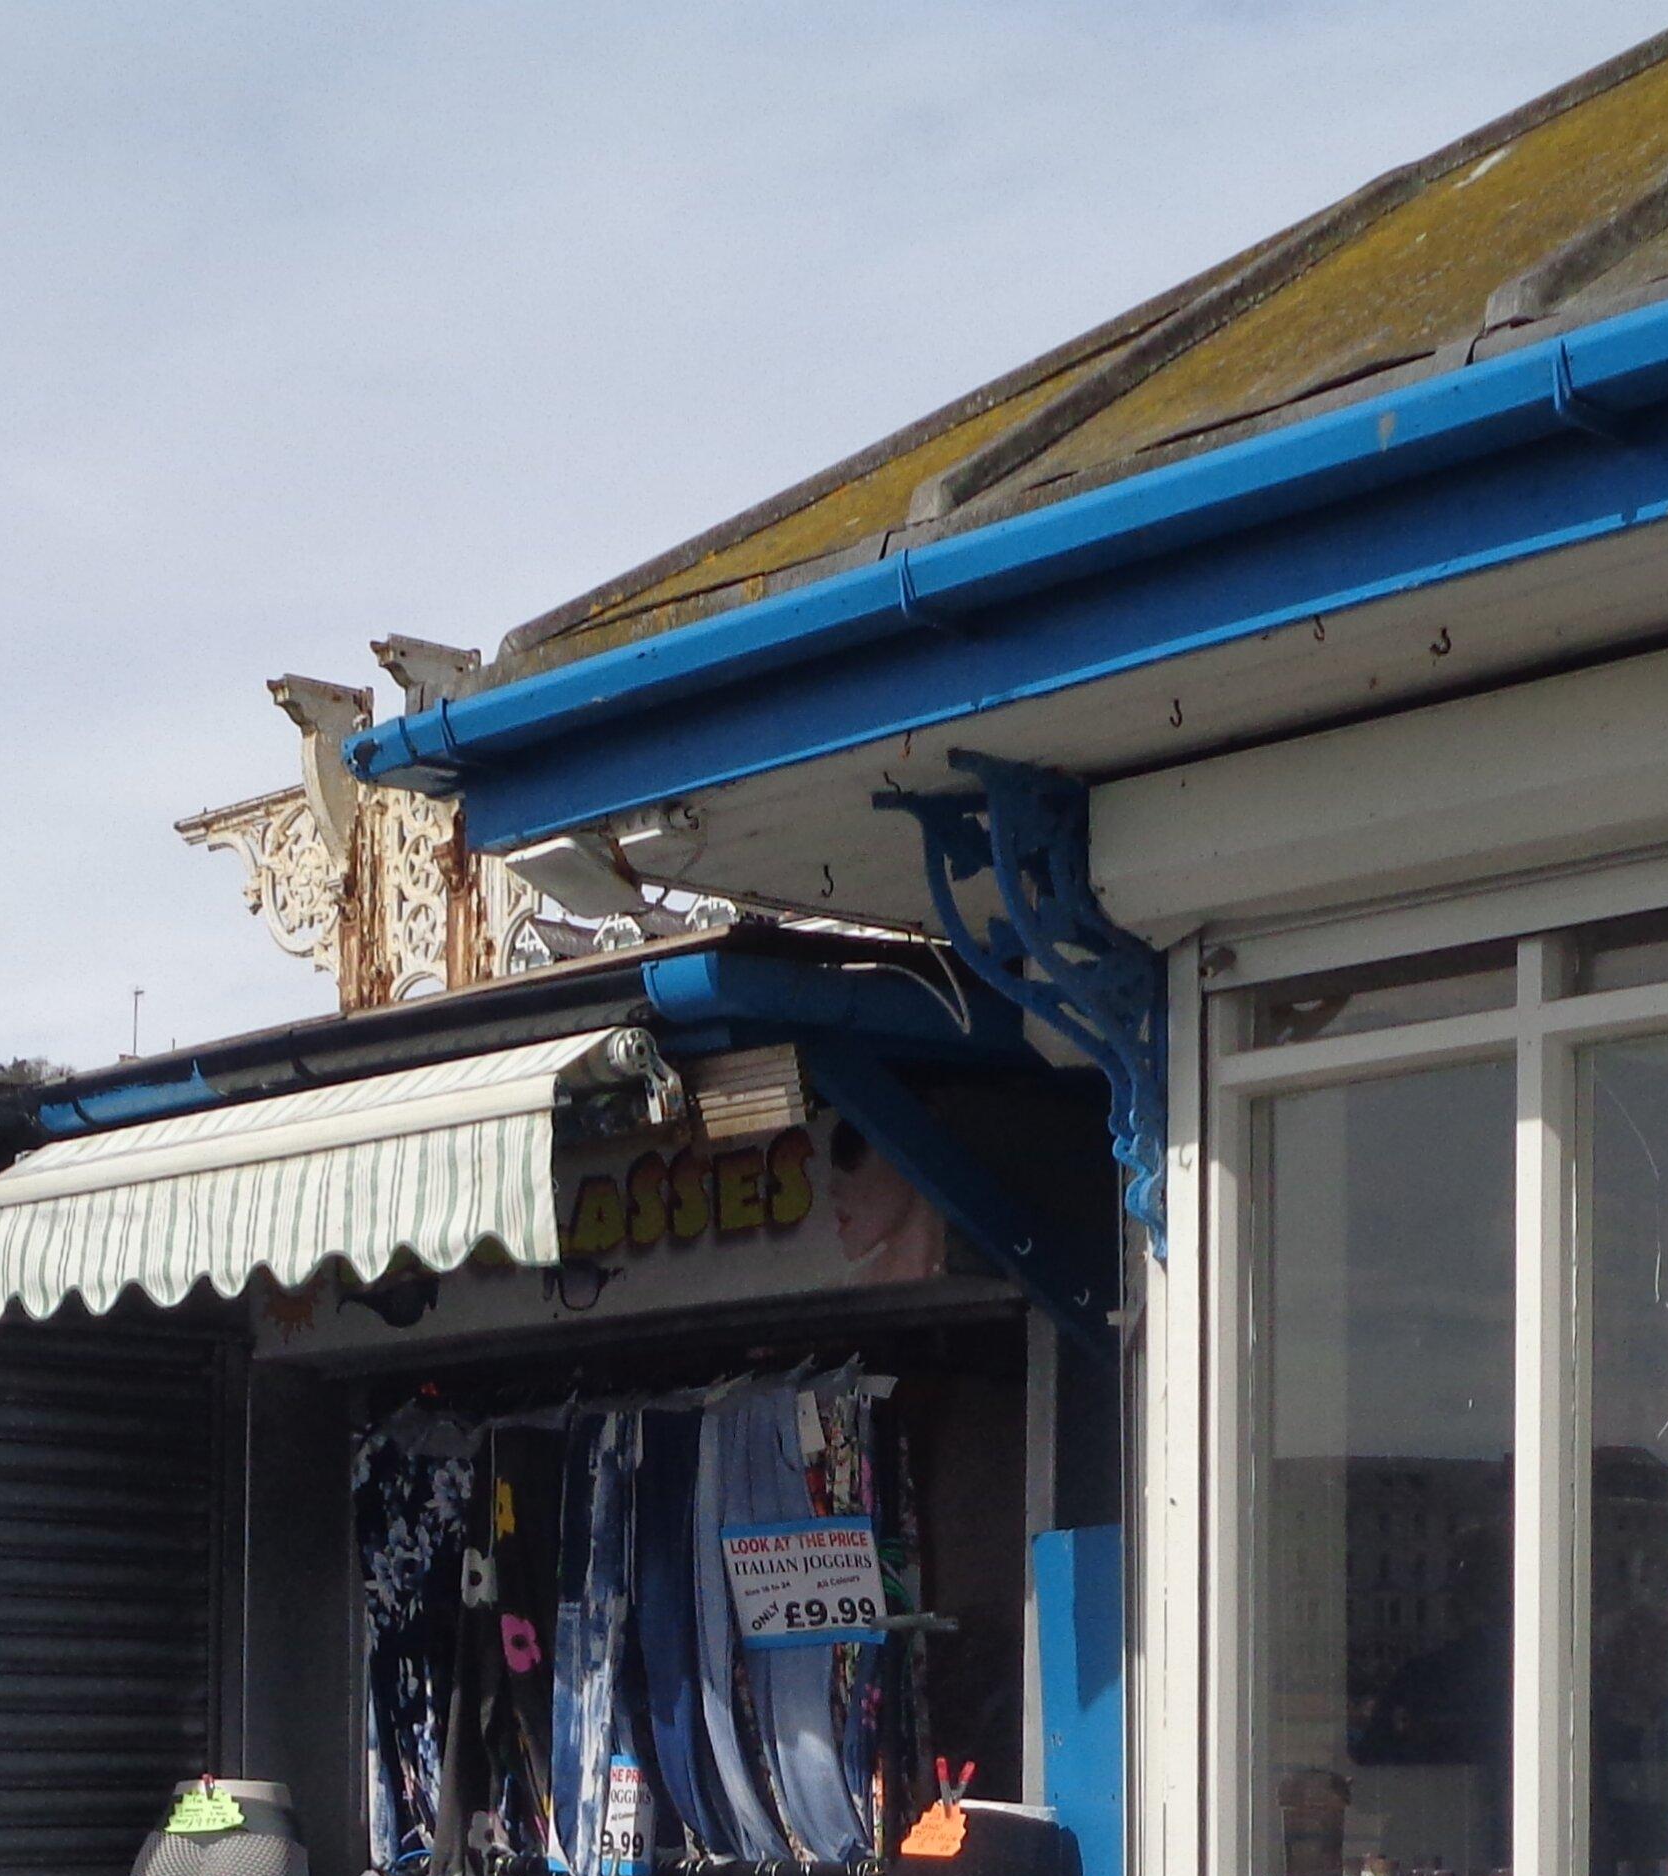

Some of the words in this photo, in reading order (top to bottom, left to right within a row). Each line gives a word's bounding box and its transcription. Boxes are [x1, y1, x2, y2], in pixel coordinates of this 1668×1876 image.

[560, 1125, 815, 1260] ASSES
[730, 1537, 769, 1555] LOOK
[774, 1535, 790, 1551] AT
[798, 1533, 825, 1550] THE
[829, 1531, 868, 1548] PRICE
[734, 1556, 799, 1576] ITALIAN
[802, 1553, 872, 1575] JOGGERS
[831, 1574, 861, 1588] Colours
[751, 1599, 781, 1632] ONLY
[784, 1597, 876, 1629] £9.99
[611, 1769, 623, 1782] HE
[611, 1789, 652, 1805] OGGERS
